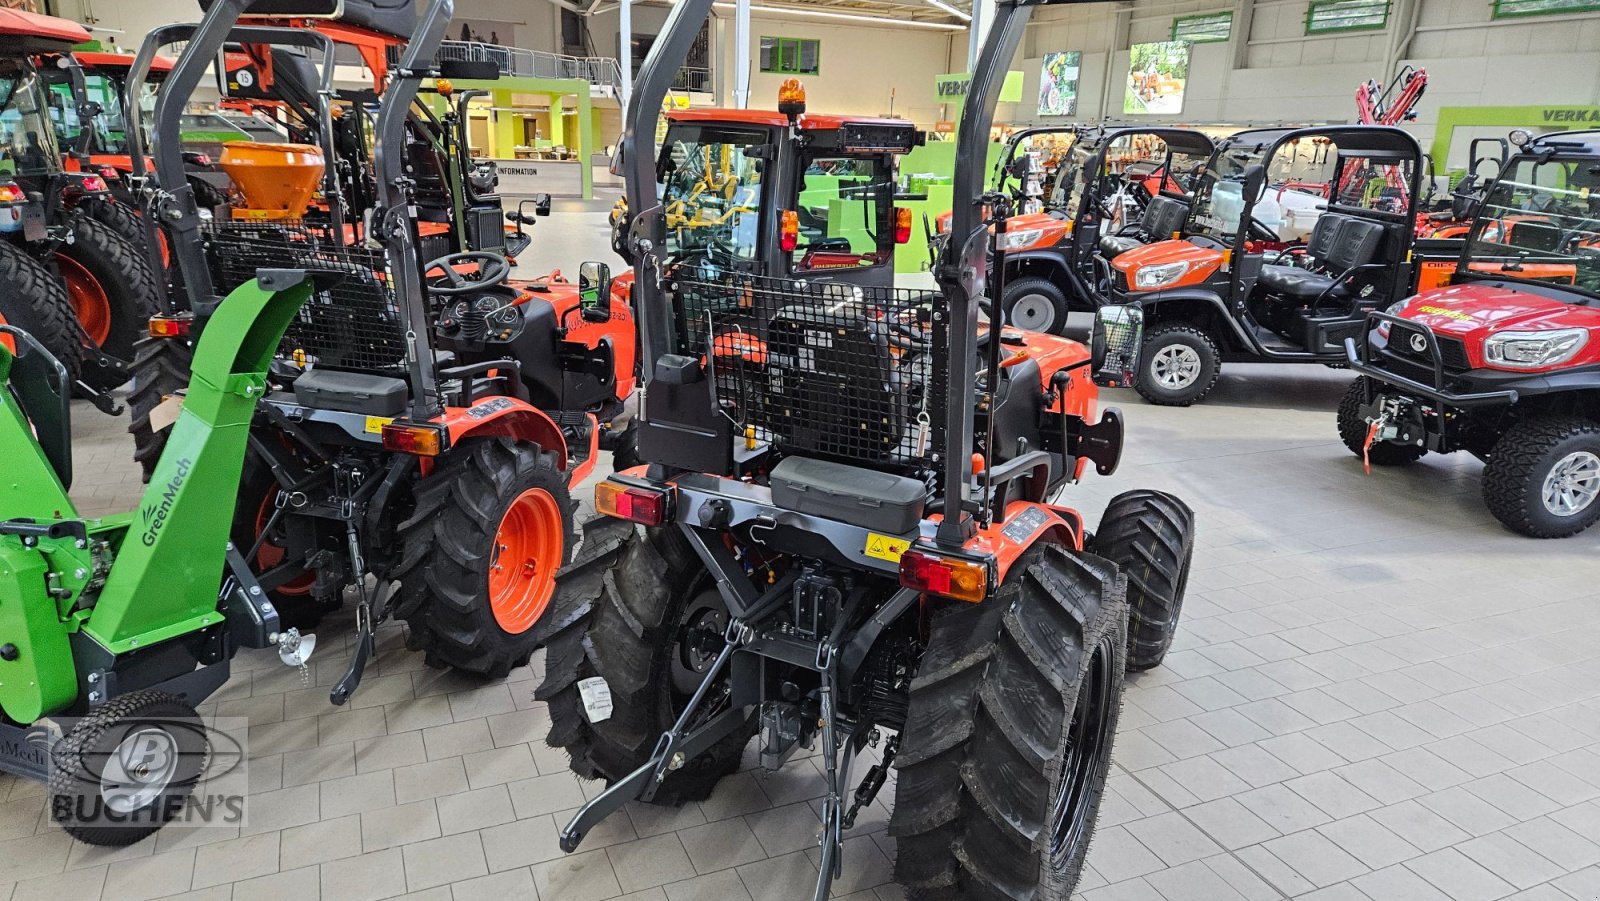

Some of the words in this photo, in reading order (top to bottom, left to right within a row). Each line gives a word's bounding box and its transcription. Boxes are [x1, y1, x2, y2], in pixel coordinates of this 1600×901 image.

[240, 73, 249, 84] 15
[497, 167, 538, 176] INFORMATION
[142, 457, 192, 547] GreenMech
